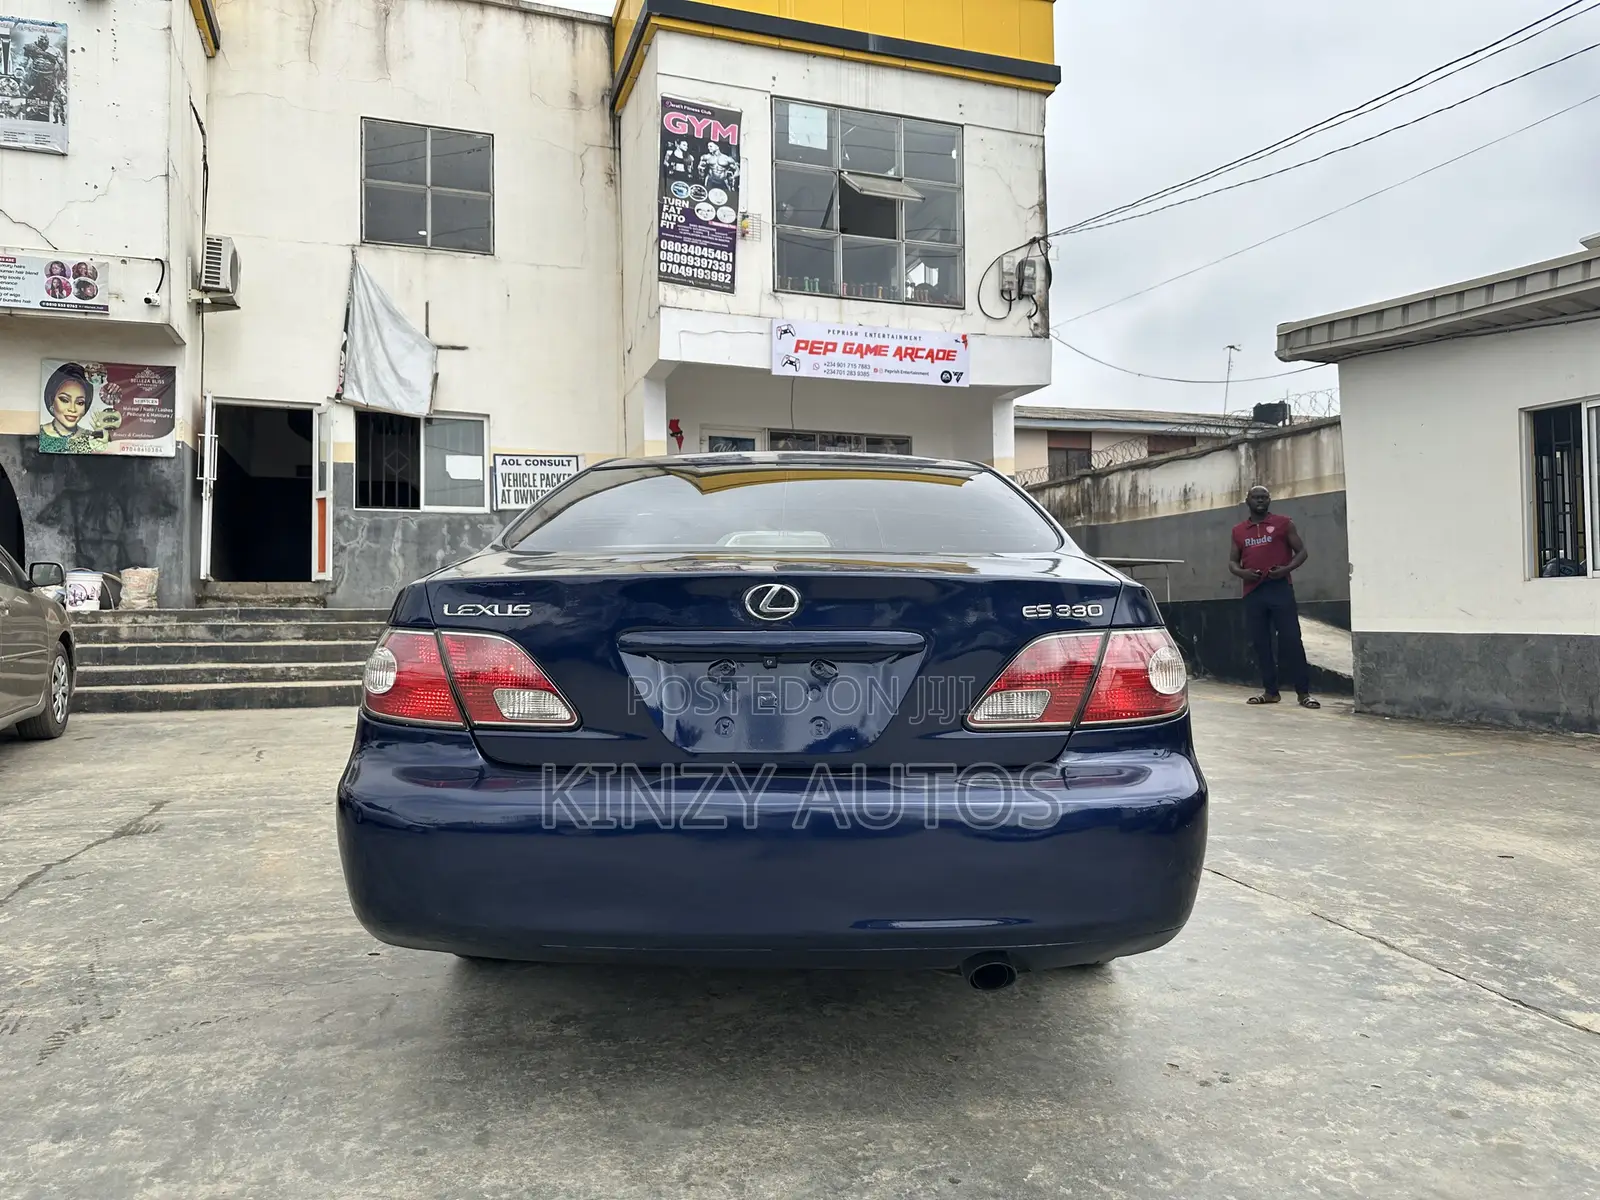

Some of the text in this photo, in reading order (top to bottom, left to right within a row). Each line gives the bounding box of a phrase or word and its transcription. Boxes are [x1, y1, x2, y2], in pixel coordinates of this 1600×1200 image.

[663, 112, 738, 145] GYM
[663, 196, 689, 208] TURN
[663, 204, 682, 215] FAT
[661, 212, 686, 223] INTO
[660, 220, 676, 230] FIT
[660, 240, 733, 263] 08034045461
[827, 328, 922, 341] PEPRISH ENTERTAINMENT
[793, 339, 957, 364] PEP GAME ARCADE
[900, 369, 930, 377] Entertainment
[501, 458, 572, 467] AOL CONSULT
[500, 472, 538, 488] VEHICLE
[501, 489, 511, 504] AT
[1244, 535, 1272, 547] Rhude
[443, 603, 532, 617] LEXUS
[1022, 603, 1104, 618] ES 330
